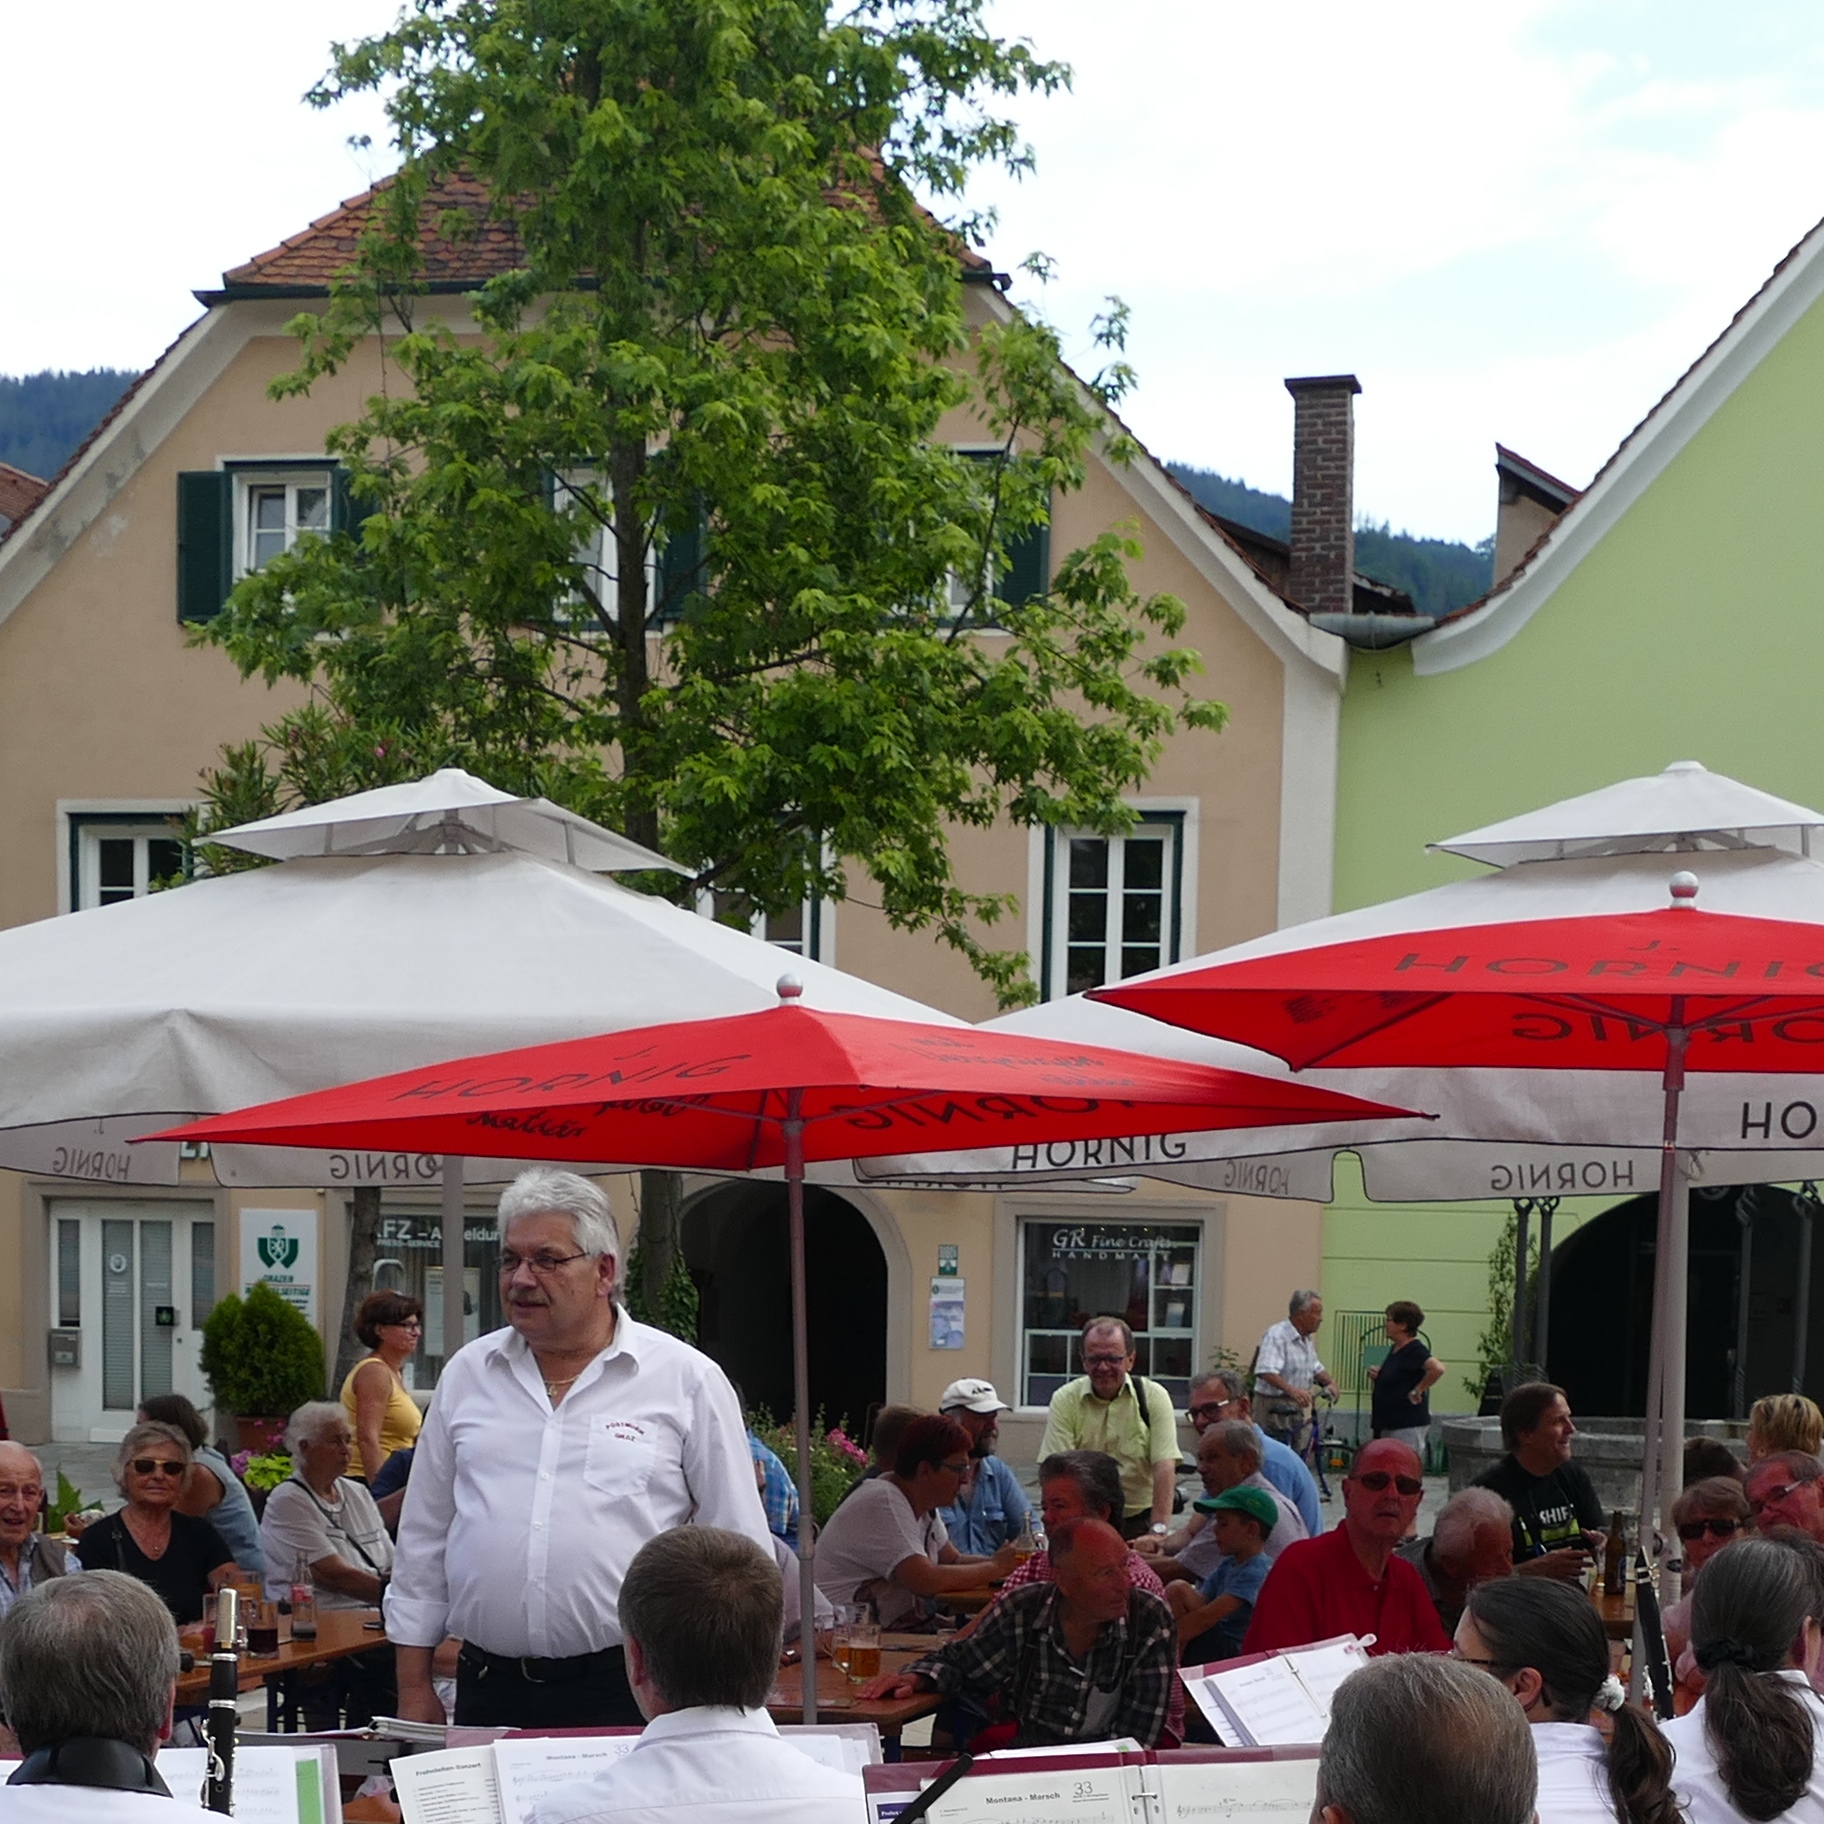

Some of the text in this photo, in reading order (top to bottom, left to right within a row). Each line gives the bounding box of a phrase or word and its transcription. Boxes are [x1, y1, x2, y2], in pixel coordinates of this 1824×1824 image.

[1012, 1134, 1187, 1169] HORNIG
[1053, 1229, 1171, 1249] GR Fine Crafts
[614, 1744, 629, 1755] 33
[986, 1792, 1060, 1804] Montana Marsch
[1073, 1782, 1093, 1798] 33
